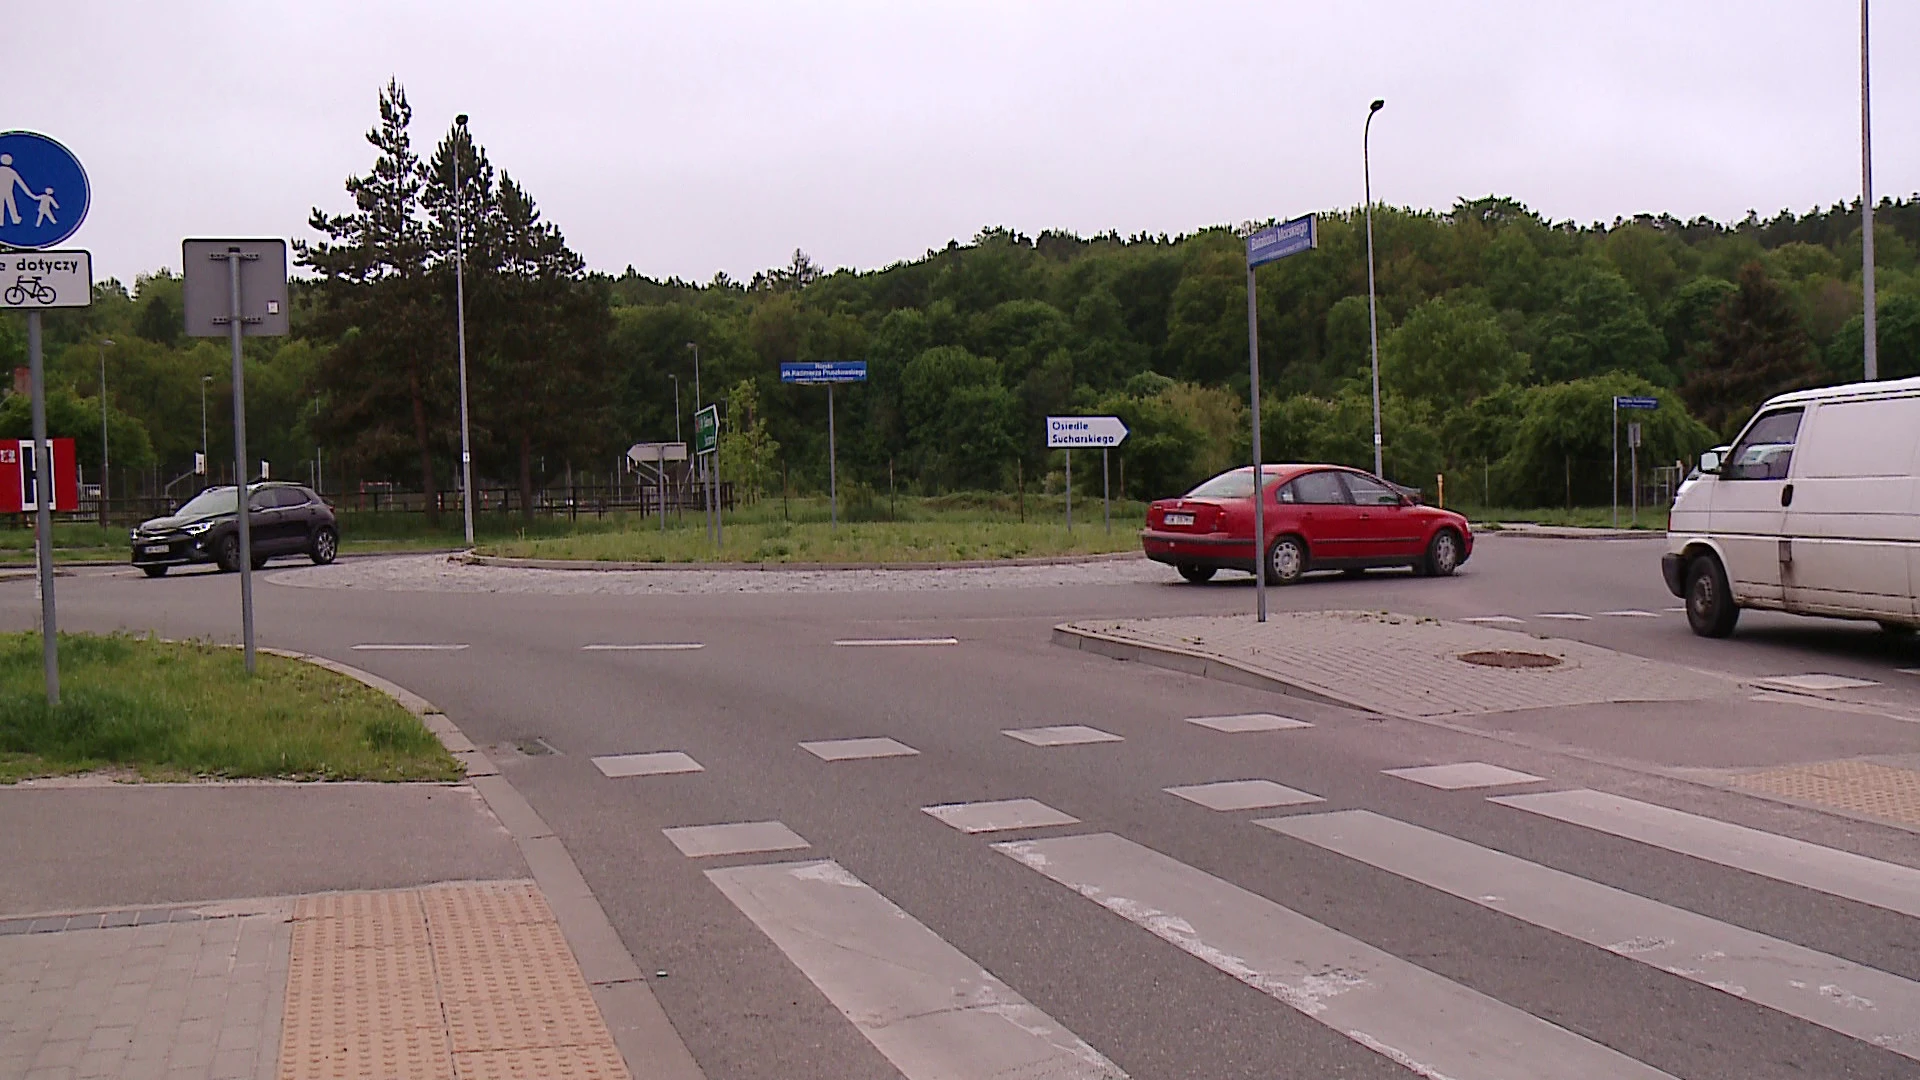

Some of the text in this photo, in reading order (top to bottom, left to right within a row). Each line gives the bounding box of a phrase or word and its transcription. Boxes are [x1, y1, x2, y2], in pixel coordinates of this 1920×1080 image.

[16, 258, 78, 275] dotyczy
[1052, 421, 1089, 430] Osiedle
[1052, 434, 1114, 444] Sucharskiego
